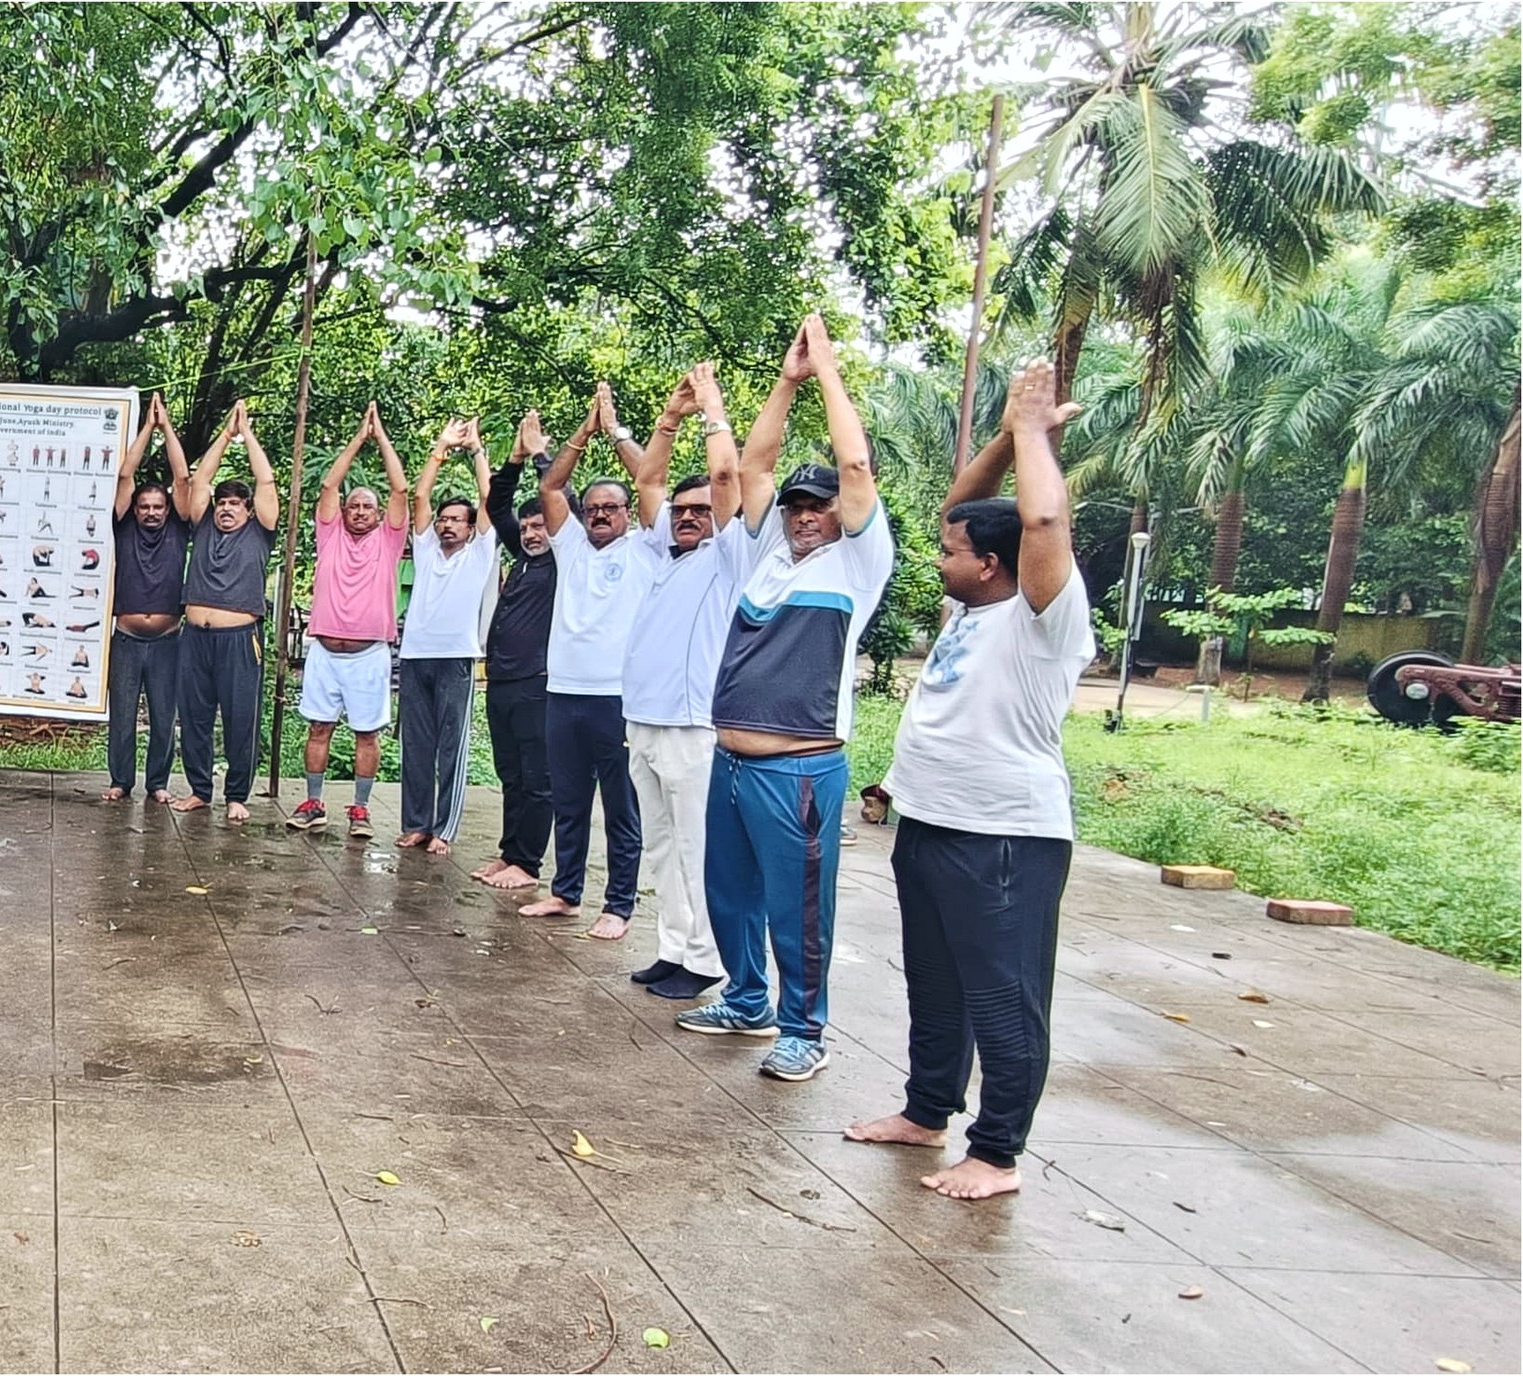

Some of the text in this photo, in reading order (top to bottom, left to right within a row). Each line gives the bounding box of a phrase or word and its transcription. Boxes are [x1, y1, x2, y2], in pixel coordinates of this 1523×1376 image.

[24, 404, 43, 413] Yoga
[45, 405, 62, 414] day
[64, 407, 102, 416] protocol
[43, 419, 74, 429] Ministry
